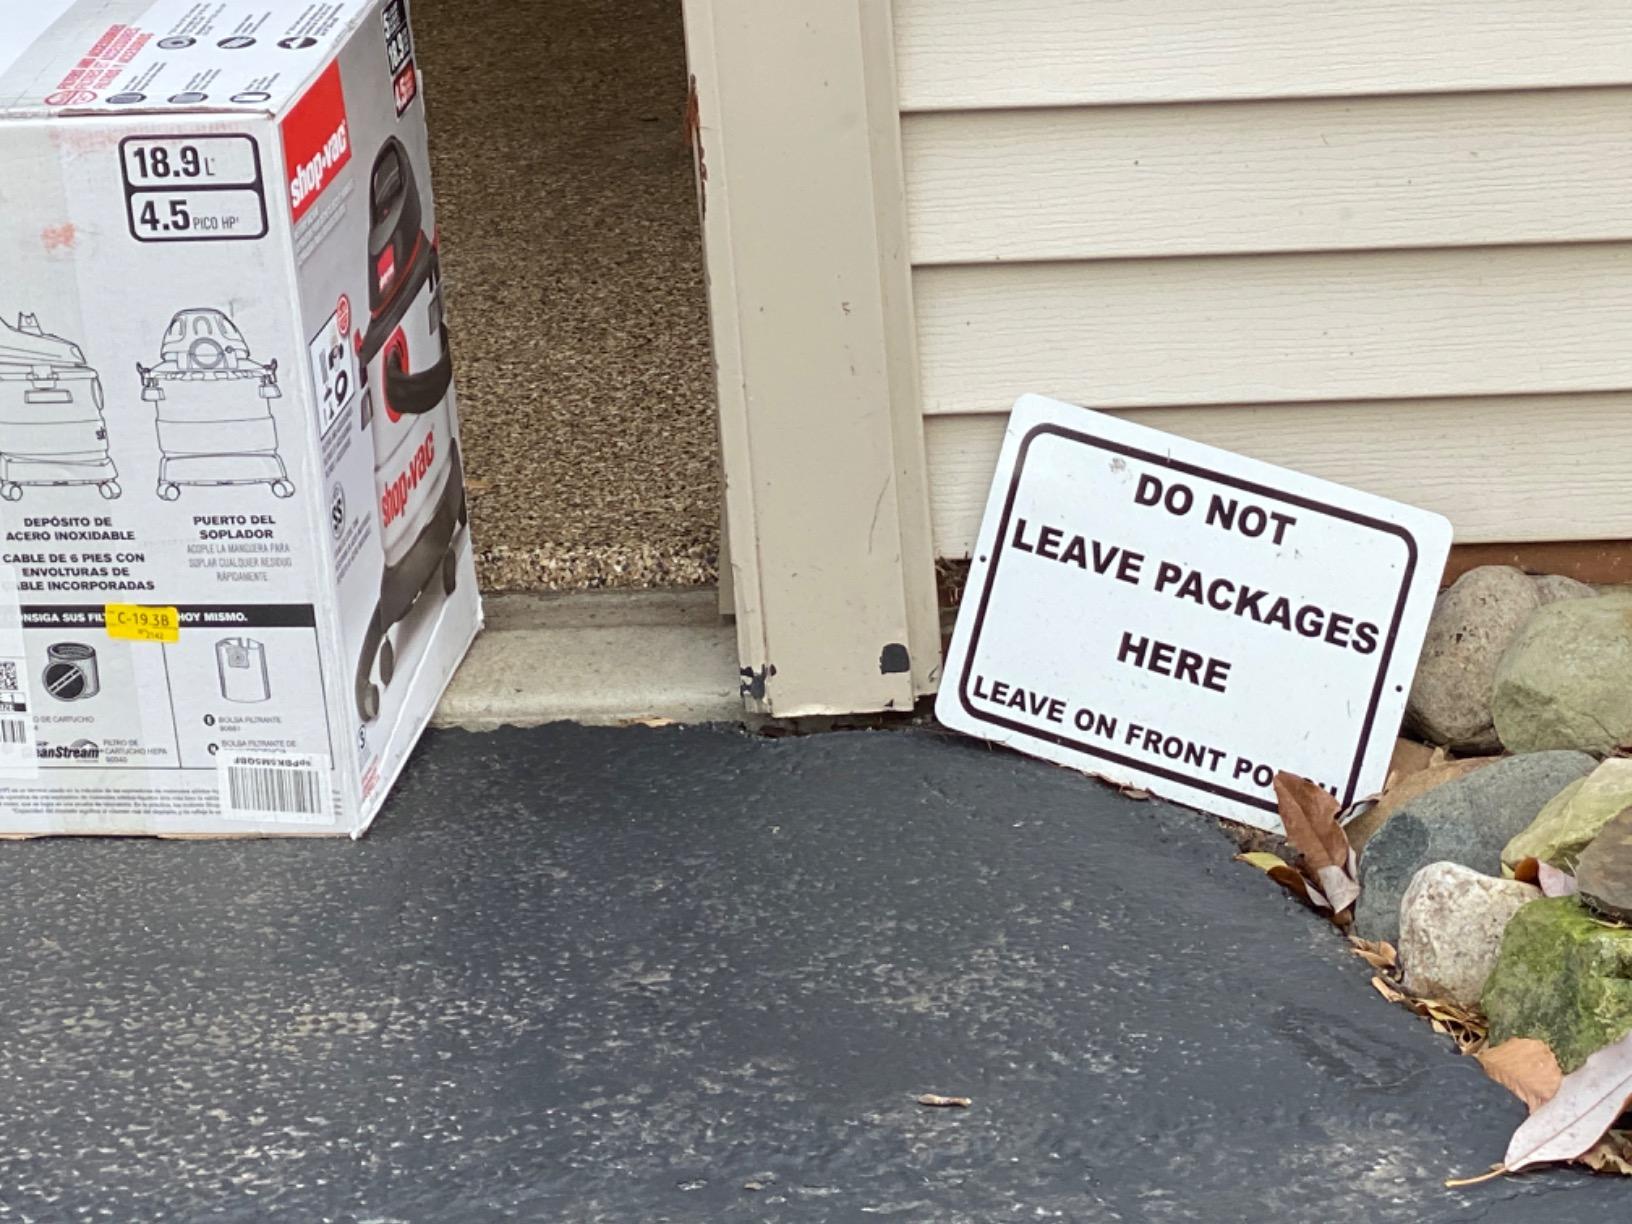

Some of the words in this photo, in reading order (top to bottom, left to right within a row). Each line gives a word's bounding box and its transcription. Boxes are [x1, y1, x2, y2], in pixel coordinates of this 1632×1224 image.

[133, 145, 201, 178] 18.9
[140, 199, 191, 231] 4.5
[193, 217, 218, 230] PICO
[1133, 474, 1194, 516] DO
[1205, 494, 1297, 546] NOT
[24, 516, 91, 527] DEPÓSITO
[94, 517, 112, 527] DE
[193, 514, 247, 525] PUERTO
[250, 514, 276, 524] DEL
[6, 531, 51, 541] ACERO
[54, 531, 136, 541] INOXIDABLE
[199, 529, 275, 539] SOPLADOR
[3, 553, 45, 563] CABLE
[49, 553, 67, 563] DE
[69, 553, 79, 563] 6
[82, 553, 112, 563] PIES
[116, 553, 145, 563] CON
[22, 567, 109, 577] ENVOLTURAS
[112, 566, 131, 577] DE
[17, 581, 44, 591] BLE
[48, 581, 155, 592] INCORPORADAS
[1011, 518, 1145, 584] LEAVE
[1154, 561, 1379, 655] PACKAGES
[22, 612, 60, 623] NSIGA
[62, 612, 86, 622] SUS
[1117, 631, 1232, 693] HERE
[973, 675, 1067, 723] LEAVE
[1074, 708, 1118, 740] ON
[1125, 723, 1227, 772] FRONT
